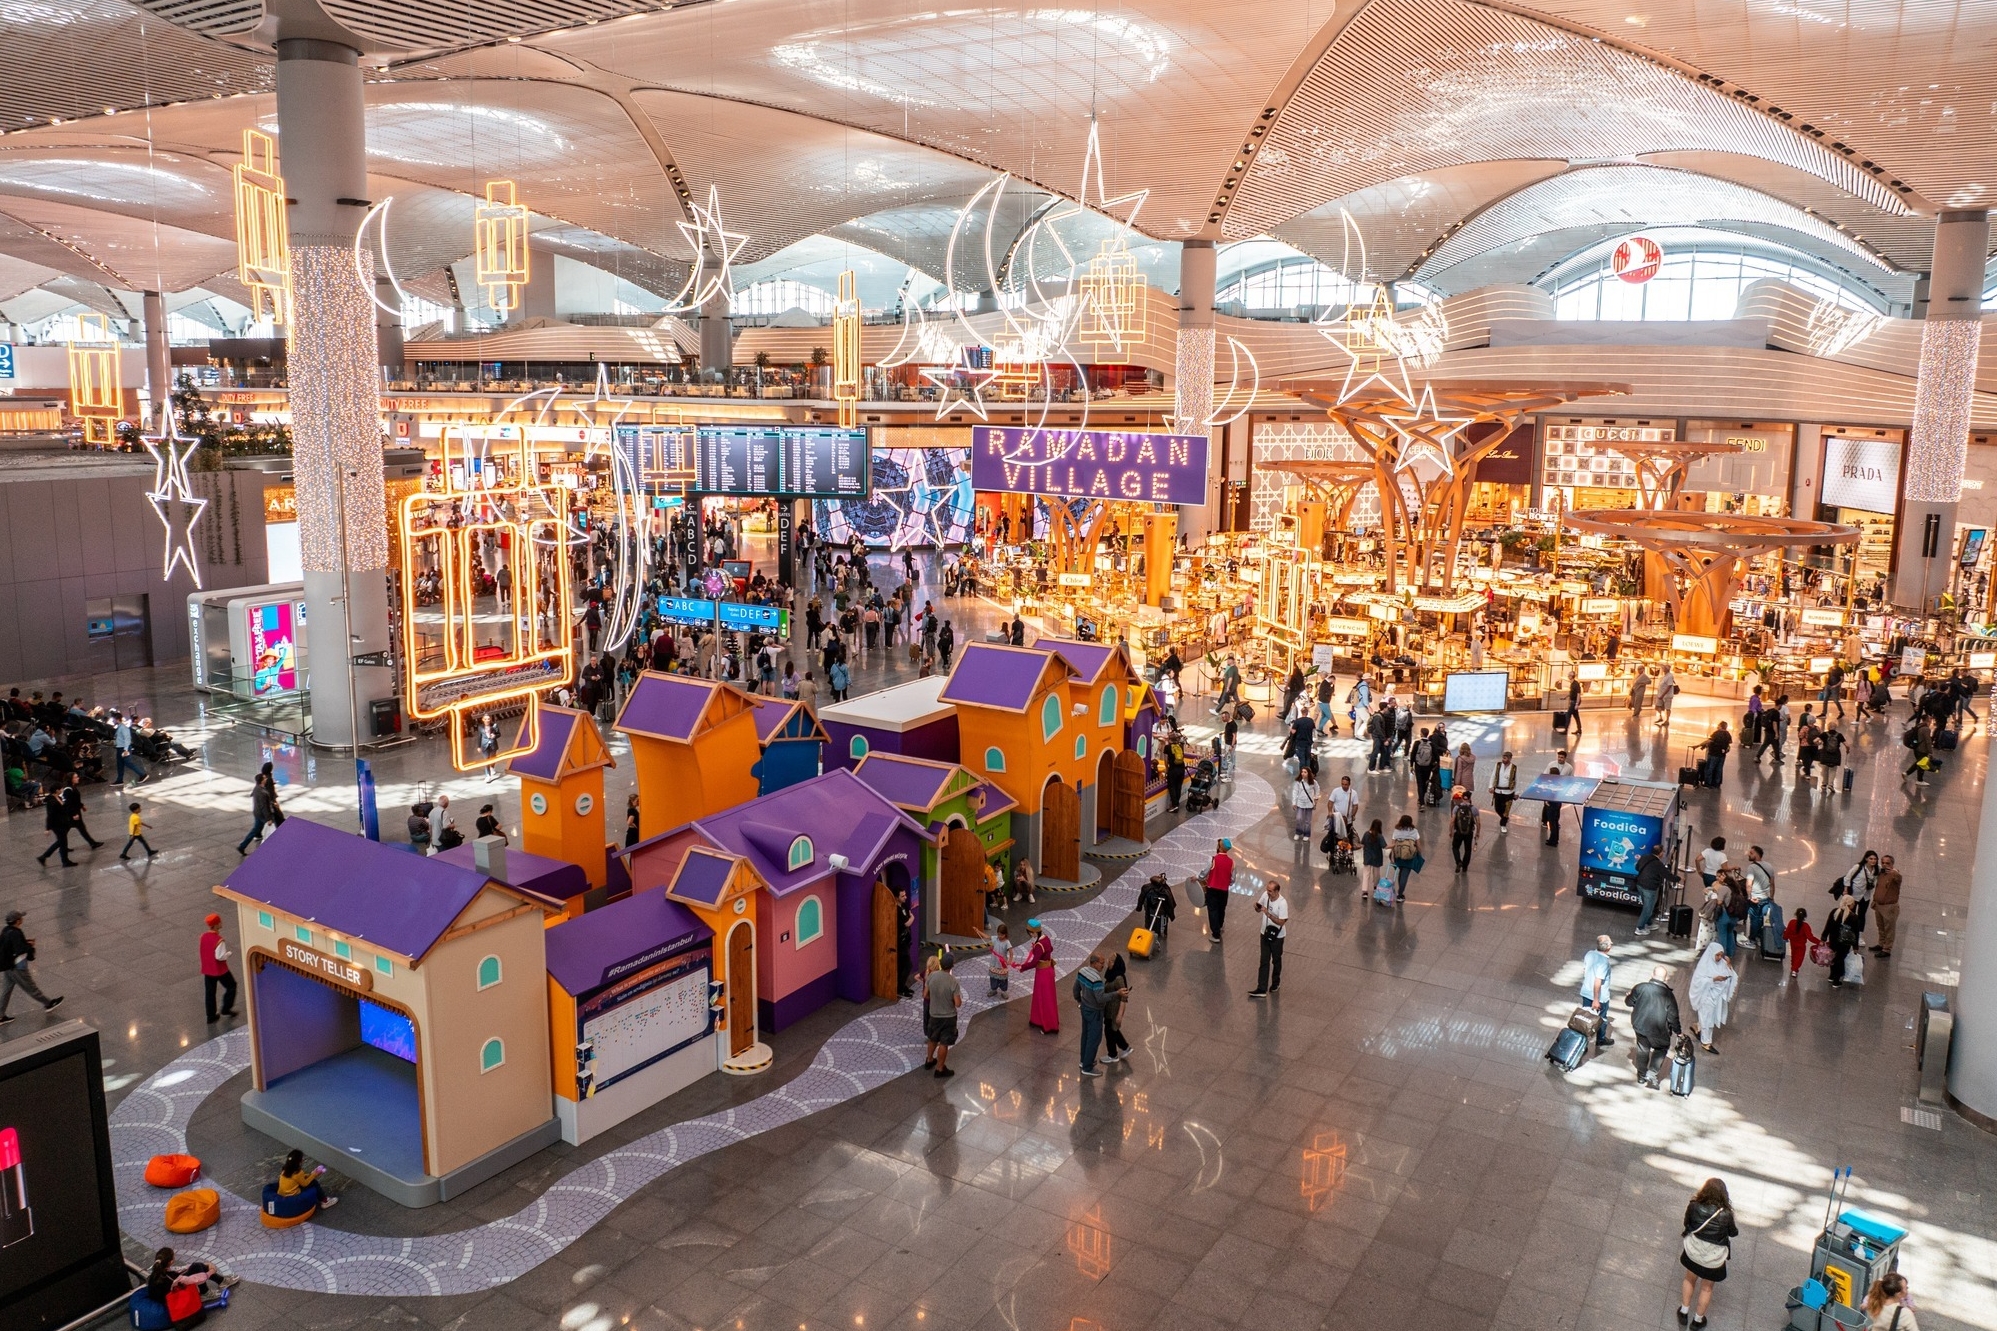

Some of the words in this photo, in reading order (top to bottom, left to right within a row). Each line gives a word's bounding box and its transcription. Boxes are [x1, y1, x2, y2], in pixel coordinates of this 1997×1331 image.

[222, 393, 235, 403] DUTY
[237, 393, 254, 403] FREE
[380, 399, 399, 410] DUTY
[402, 399, 428, 410] FREE
[1584, 429, 1637, 440] GUCCI
[988, 429, 1188, 466] RAMADAN
[1727, 438, 1767, 452] FENDI
[1305, 448, 1333, 460] DIOR
[1842, 464, 1883, 482] PRADA
[1003, 463, 1169, 499] VILLAGE
[1808, 614, 1836, 622] BURBERRY
[1330, 623, 1366, 632] GIVENCHY
[193, 620, 203, 685] exchange
[1593, 818, 1647, 835] FoodiGa
[1593, 887, 1638, 902] FoodiGa
[285, 944, 319, 968] STORY
[321, 958, 361, 985] TELLER
